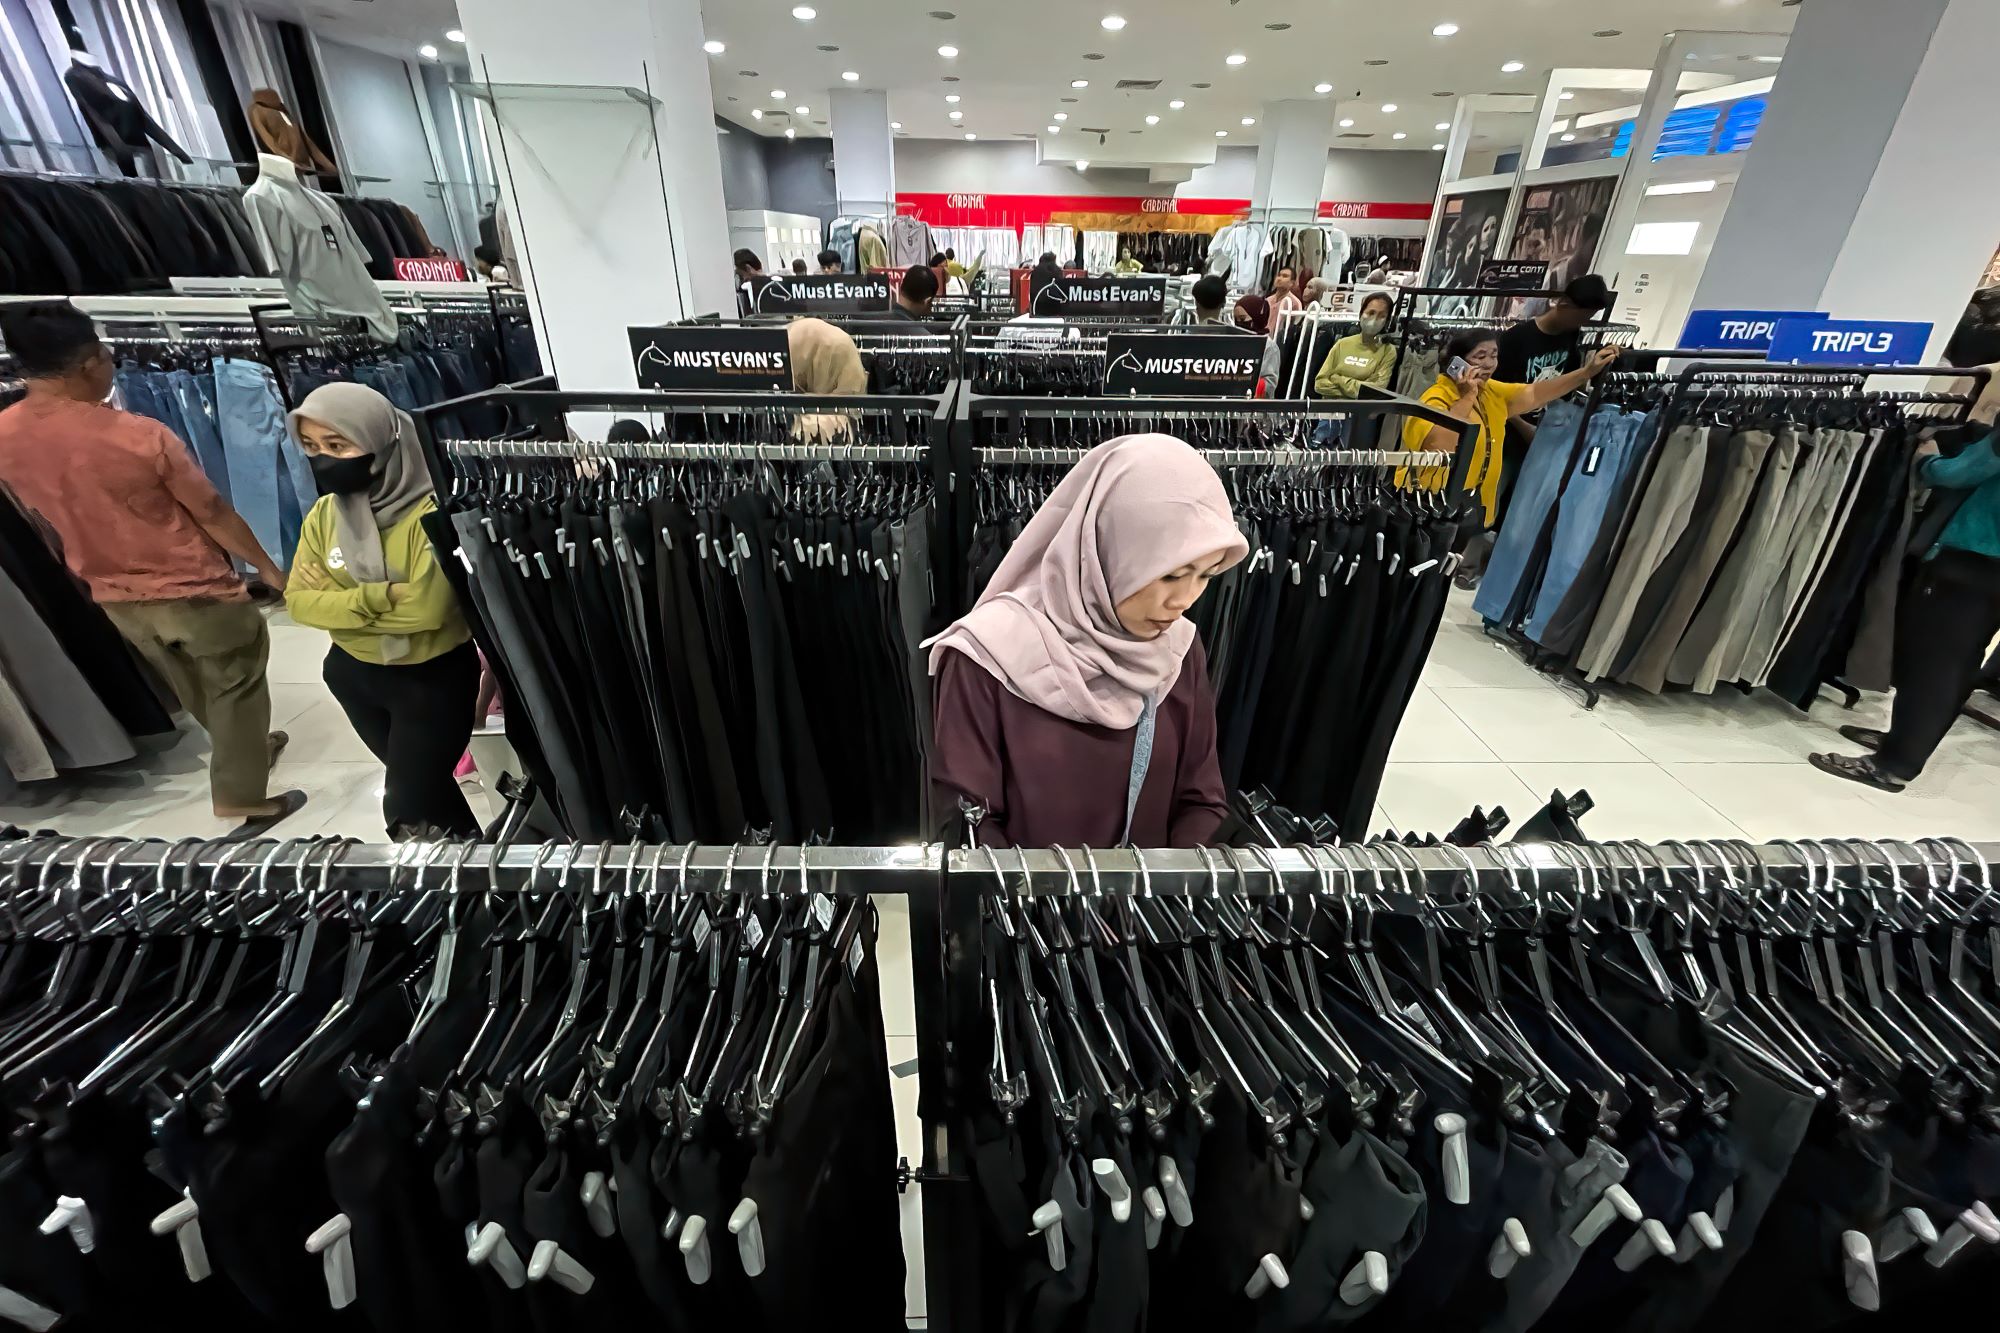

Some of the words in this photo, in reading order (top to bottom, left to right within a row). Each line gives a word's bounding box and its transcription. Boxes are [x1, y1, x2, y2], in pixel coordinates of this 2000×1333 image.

[947, 194, 985, 209] CARDINAL
[1141, 199, 1178, 213] CARDINAL
[1332, 203, 1369, 217] CARDINAL
[398, 260, 460, 281] CARDINAL
[1720, 320, 1776, 340] TRIPL
[673, 350, 784, 368] MUSTEVAN'S
[1144, 358, 1255, 374] MUSTEVAN'S
